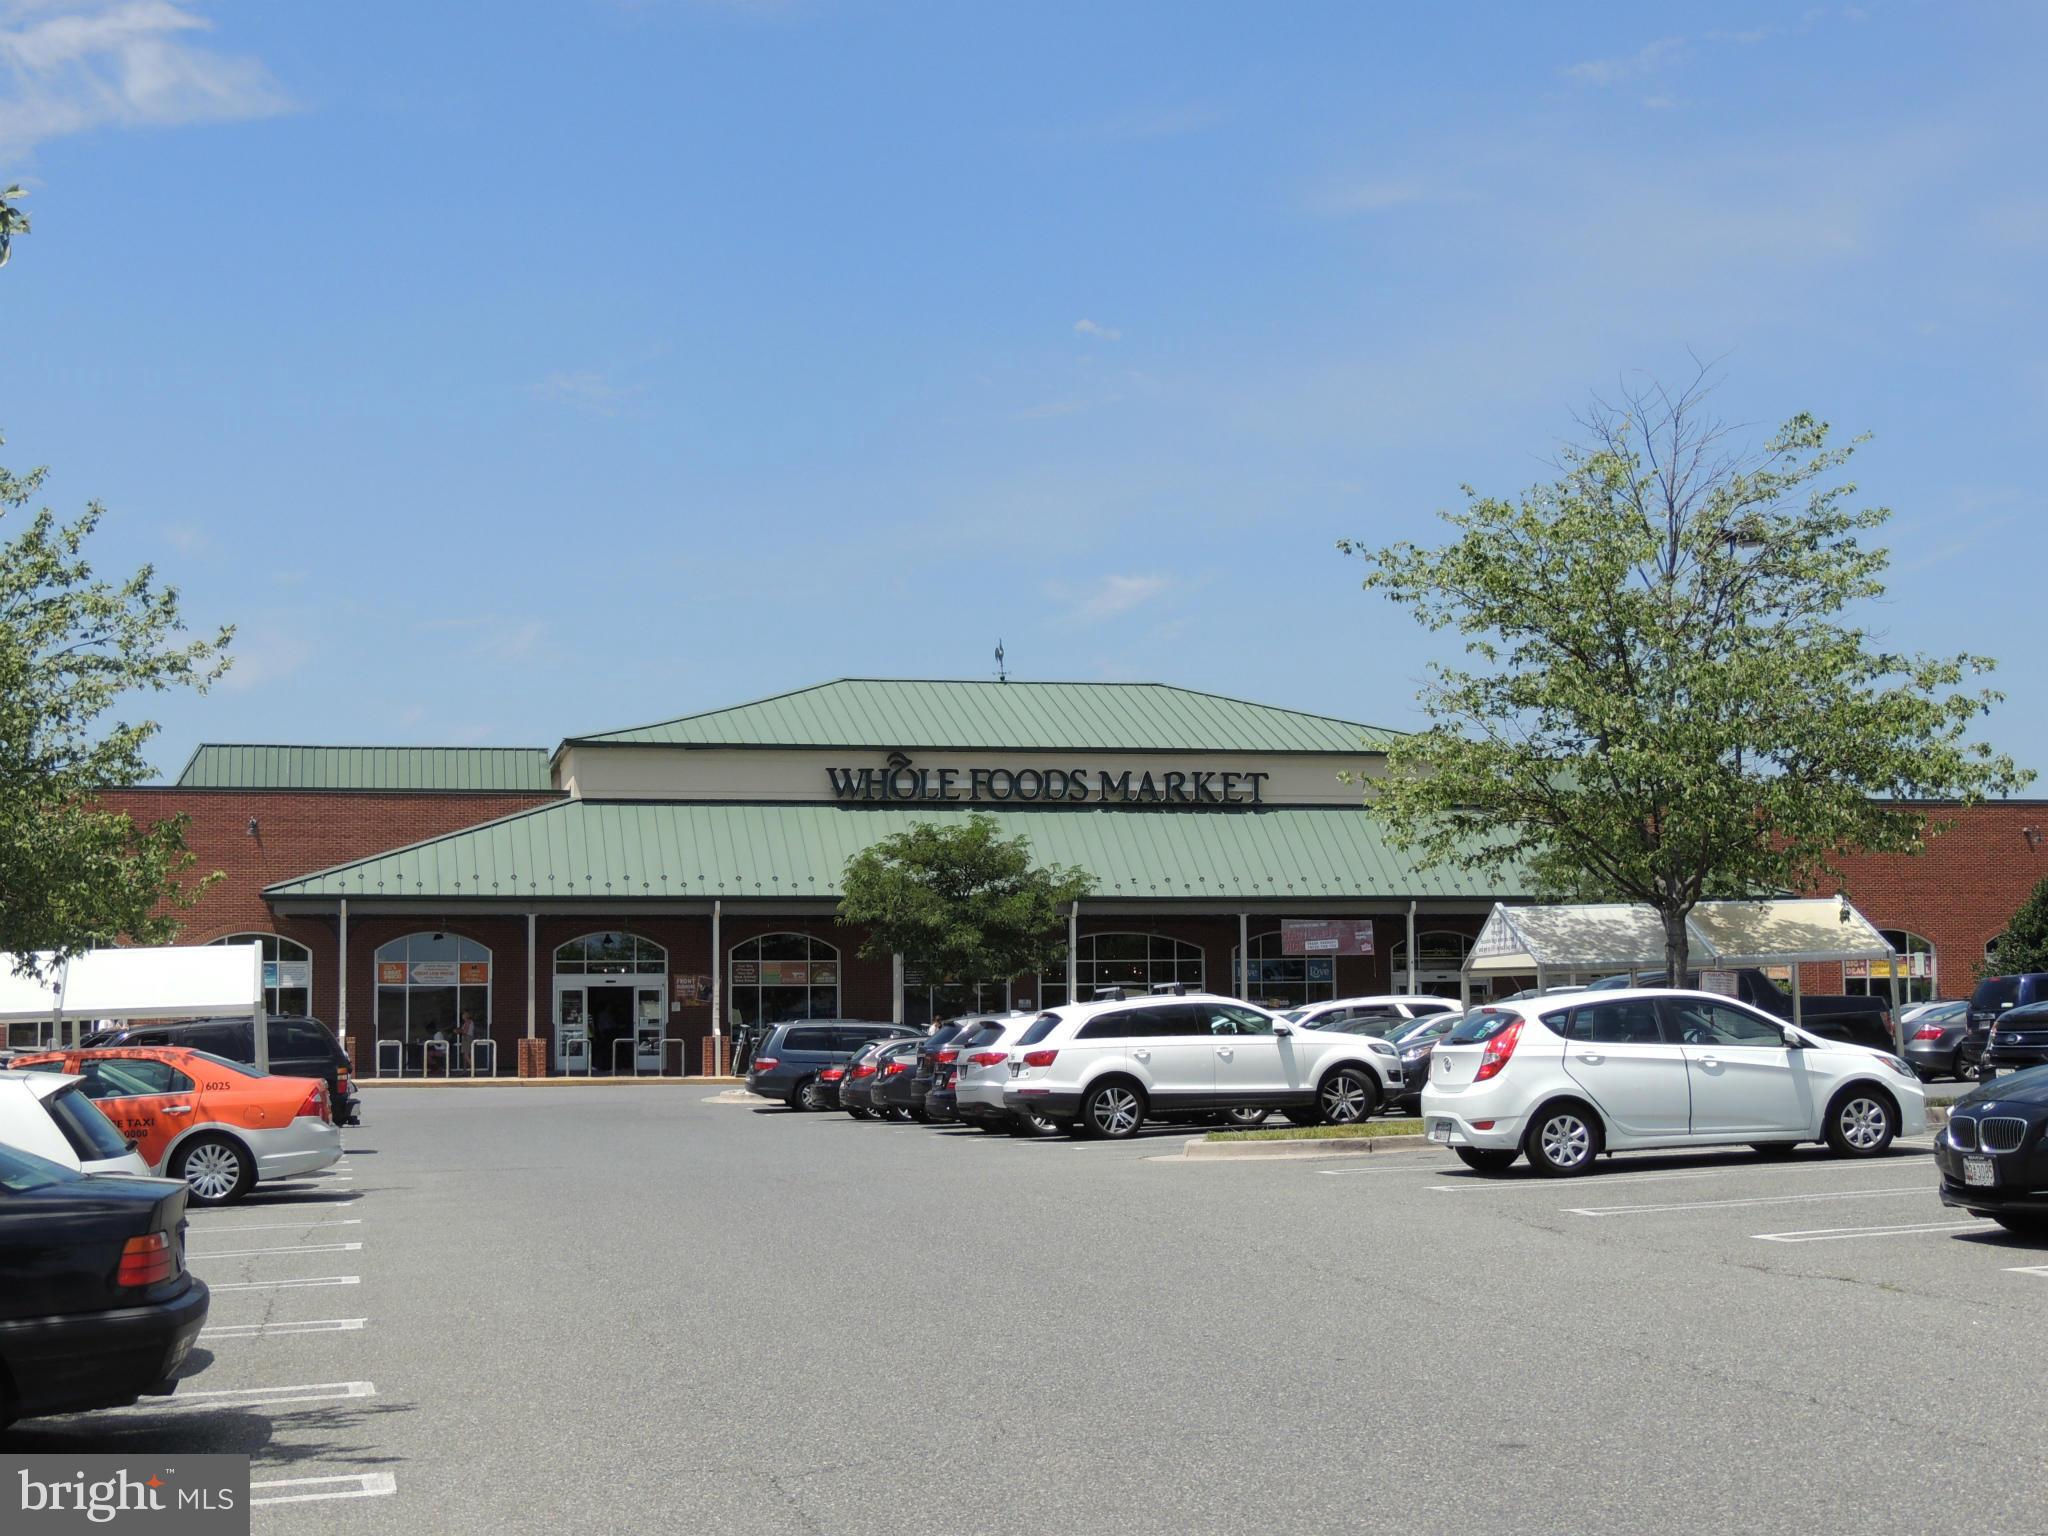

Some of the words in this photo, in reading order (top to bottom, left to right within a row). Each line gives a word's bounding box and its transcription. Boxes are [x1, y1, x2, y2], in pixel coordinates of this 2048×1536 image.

[826, 765, 961, 801] WHOLE
[969, 767, 1090, 802] FOODS
[1098, 769, 1269, 804] MARKET
[205, 1081, 231, 1091] 6025
[127, 1117, 155, 1128] TAXI
